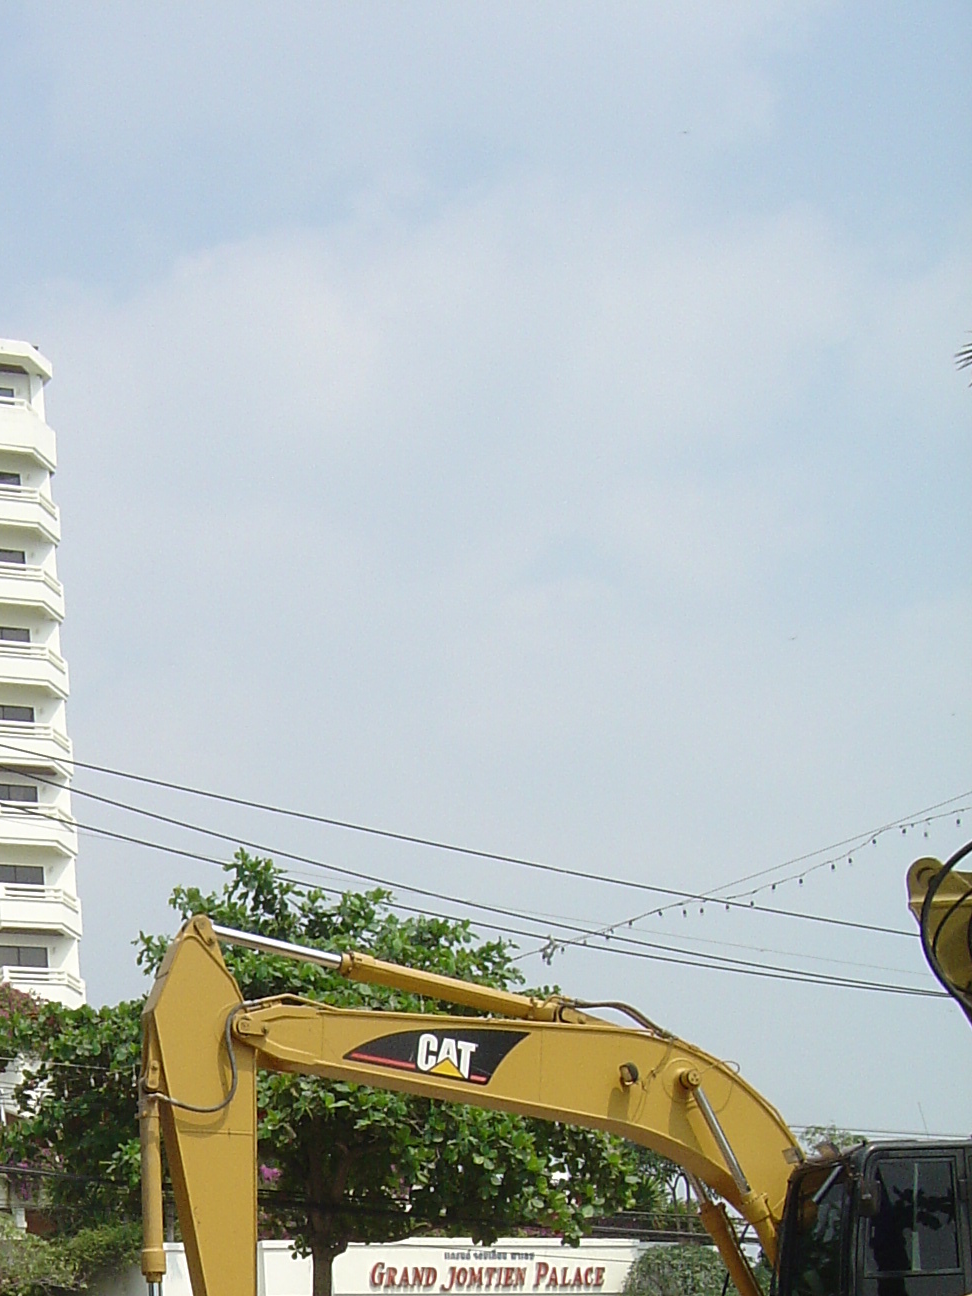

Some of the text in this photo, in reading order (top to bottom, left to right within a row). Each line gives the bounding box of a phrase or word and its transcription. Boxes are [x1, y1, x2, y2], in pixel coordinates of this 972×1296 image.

[417, 1033, 476, 1079] CAT
[371, 1262, 605, 1291] GRAND JOMTIEN PALACE
